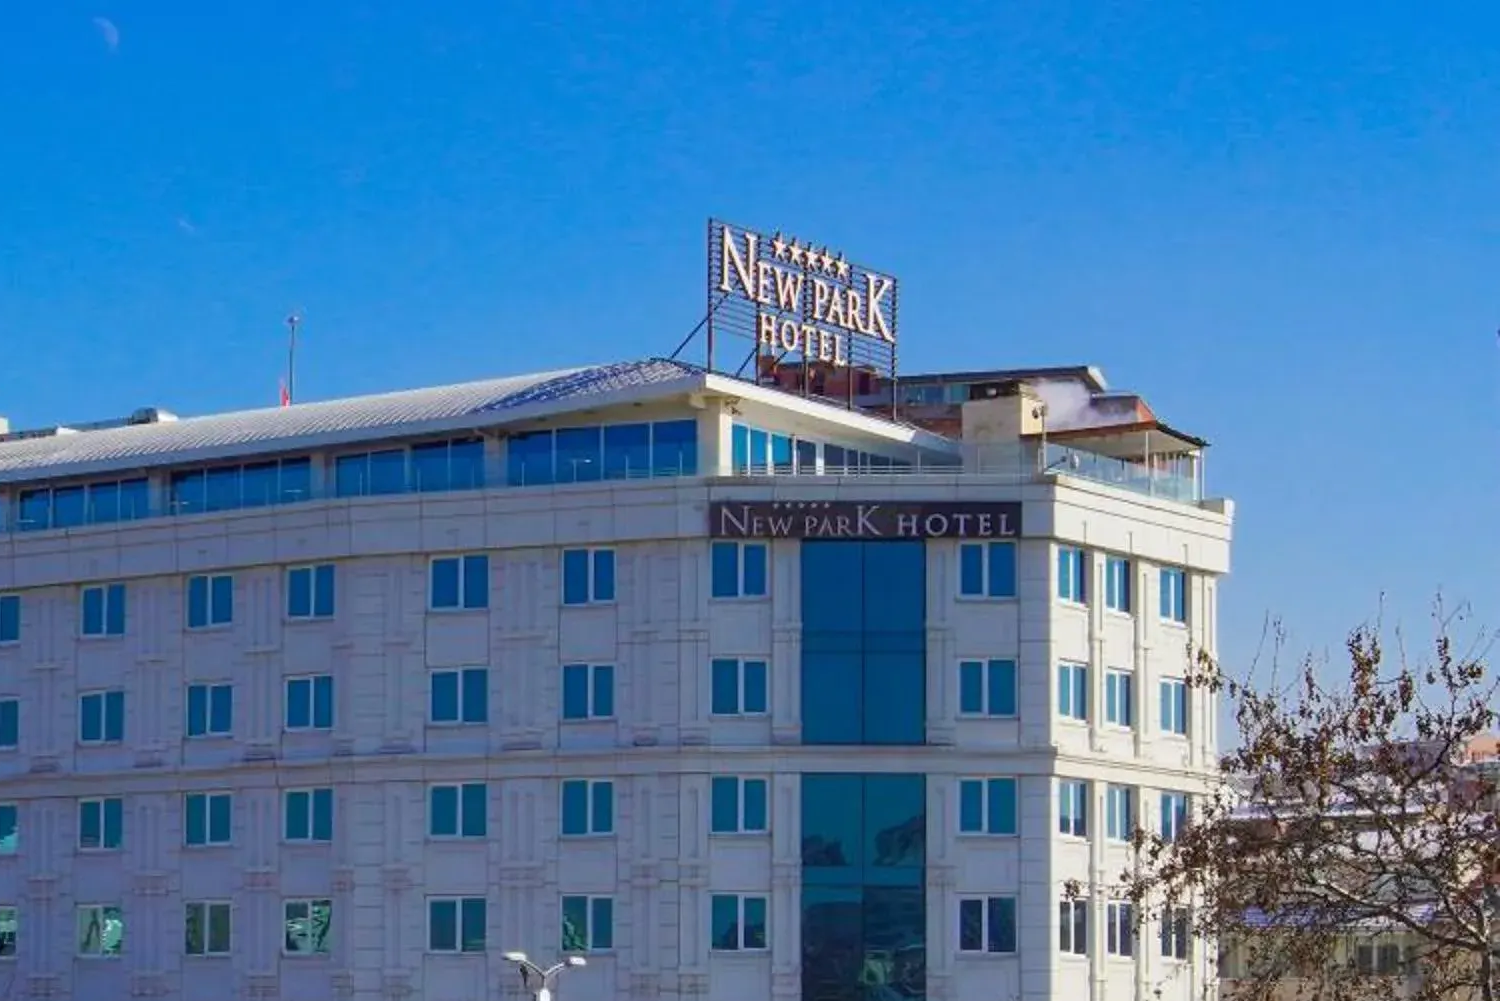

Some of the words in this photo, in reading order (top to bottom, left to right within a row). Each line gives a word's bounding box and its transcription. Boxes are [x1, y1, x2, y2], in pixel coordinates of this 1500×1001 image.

[719, 224, 804, 313] NEW
[812, 271, 895, 343] PARK
[759, 311, 846, 367] HOTEL
[720, 505, 793, 537] NEW
[804, 505, 884, 537] PARK
[897, 512, 1016, 537] HOTEL
